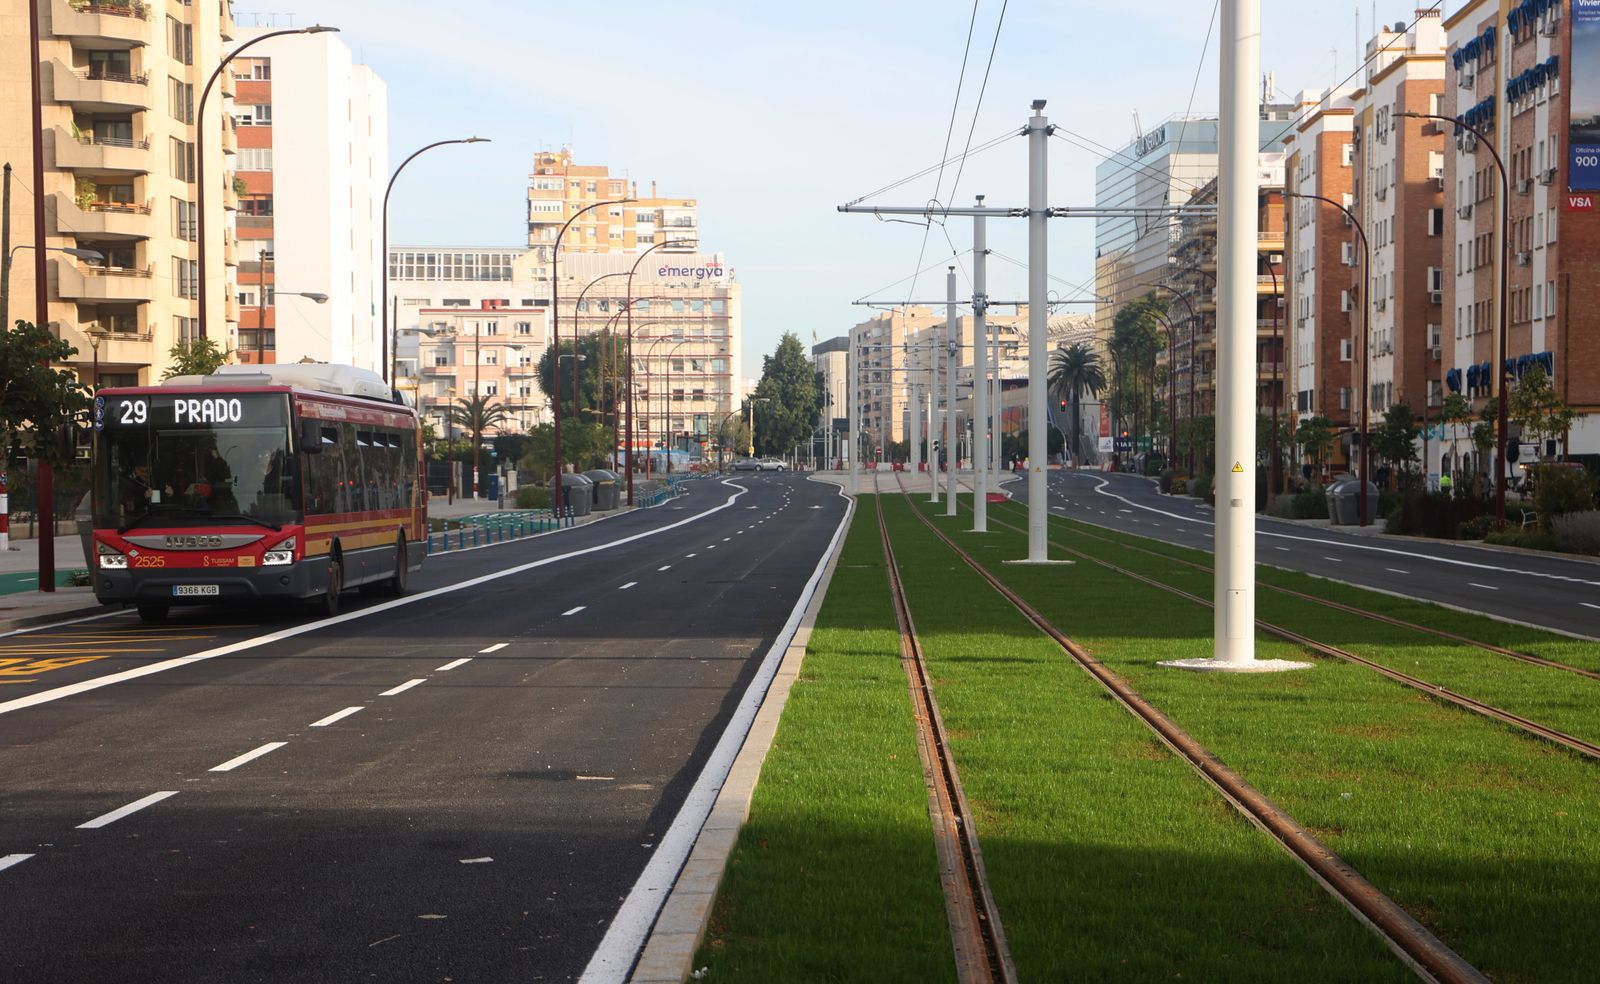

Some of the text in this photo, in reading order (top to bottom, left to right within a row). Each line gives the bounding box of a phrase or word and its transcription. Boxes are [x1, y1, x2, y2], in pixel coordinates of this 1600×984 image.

[1575, 156, 1598, 167] 900
[658, 265, 723, 279] emergya
[120, 399, 241, 424] 29 PRADO
[135, 556, 165, 567] 2525
[178, 586, 217, 594] 9366 KGB
